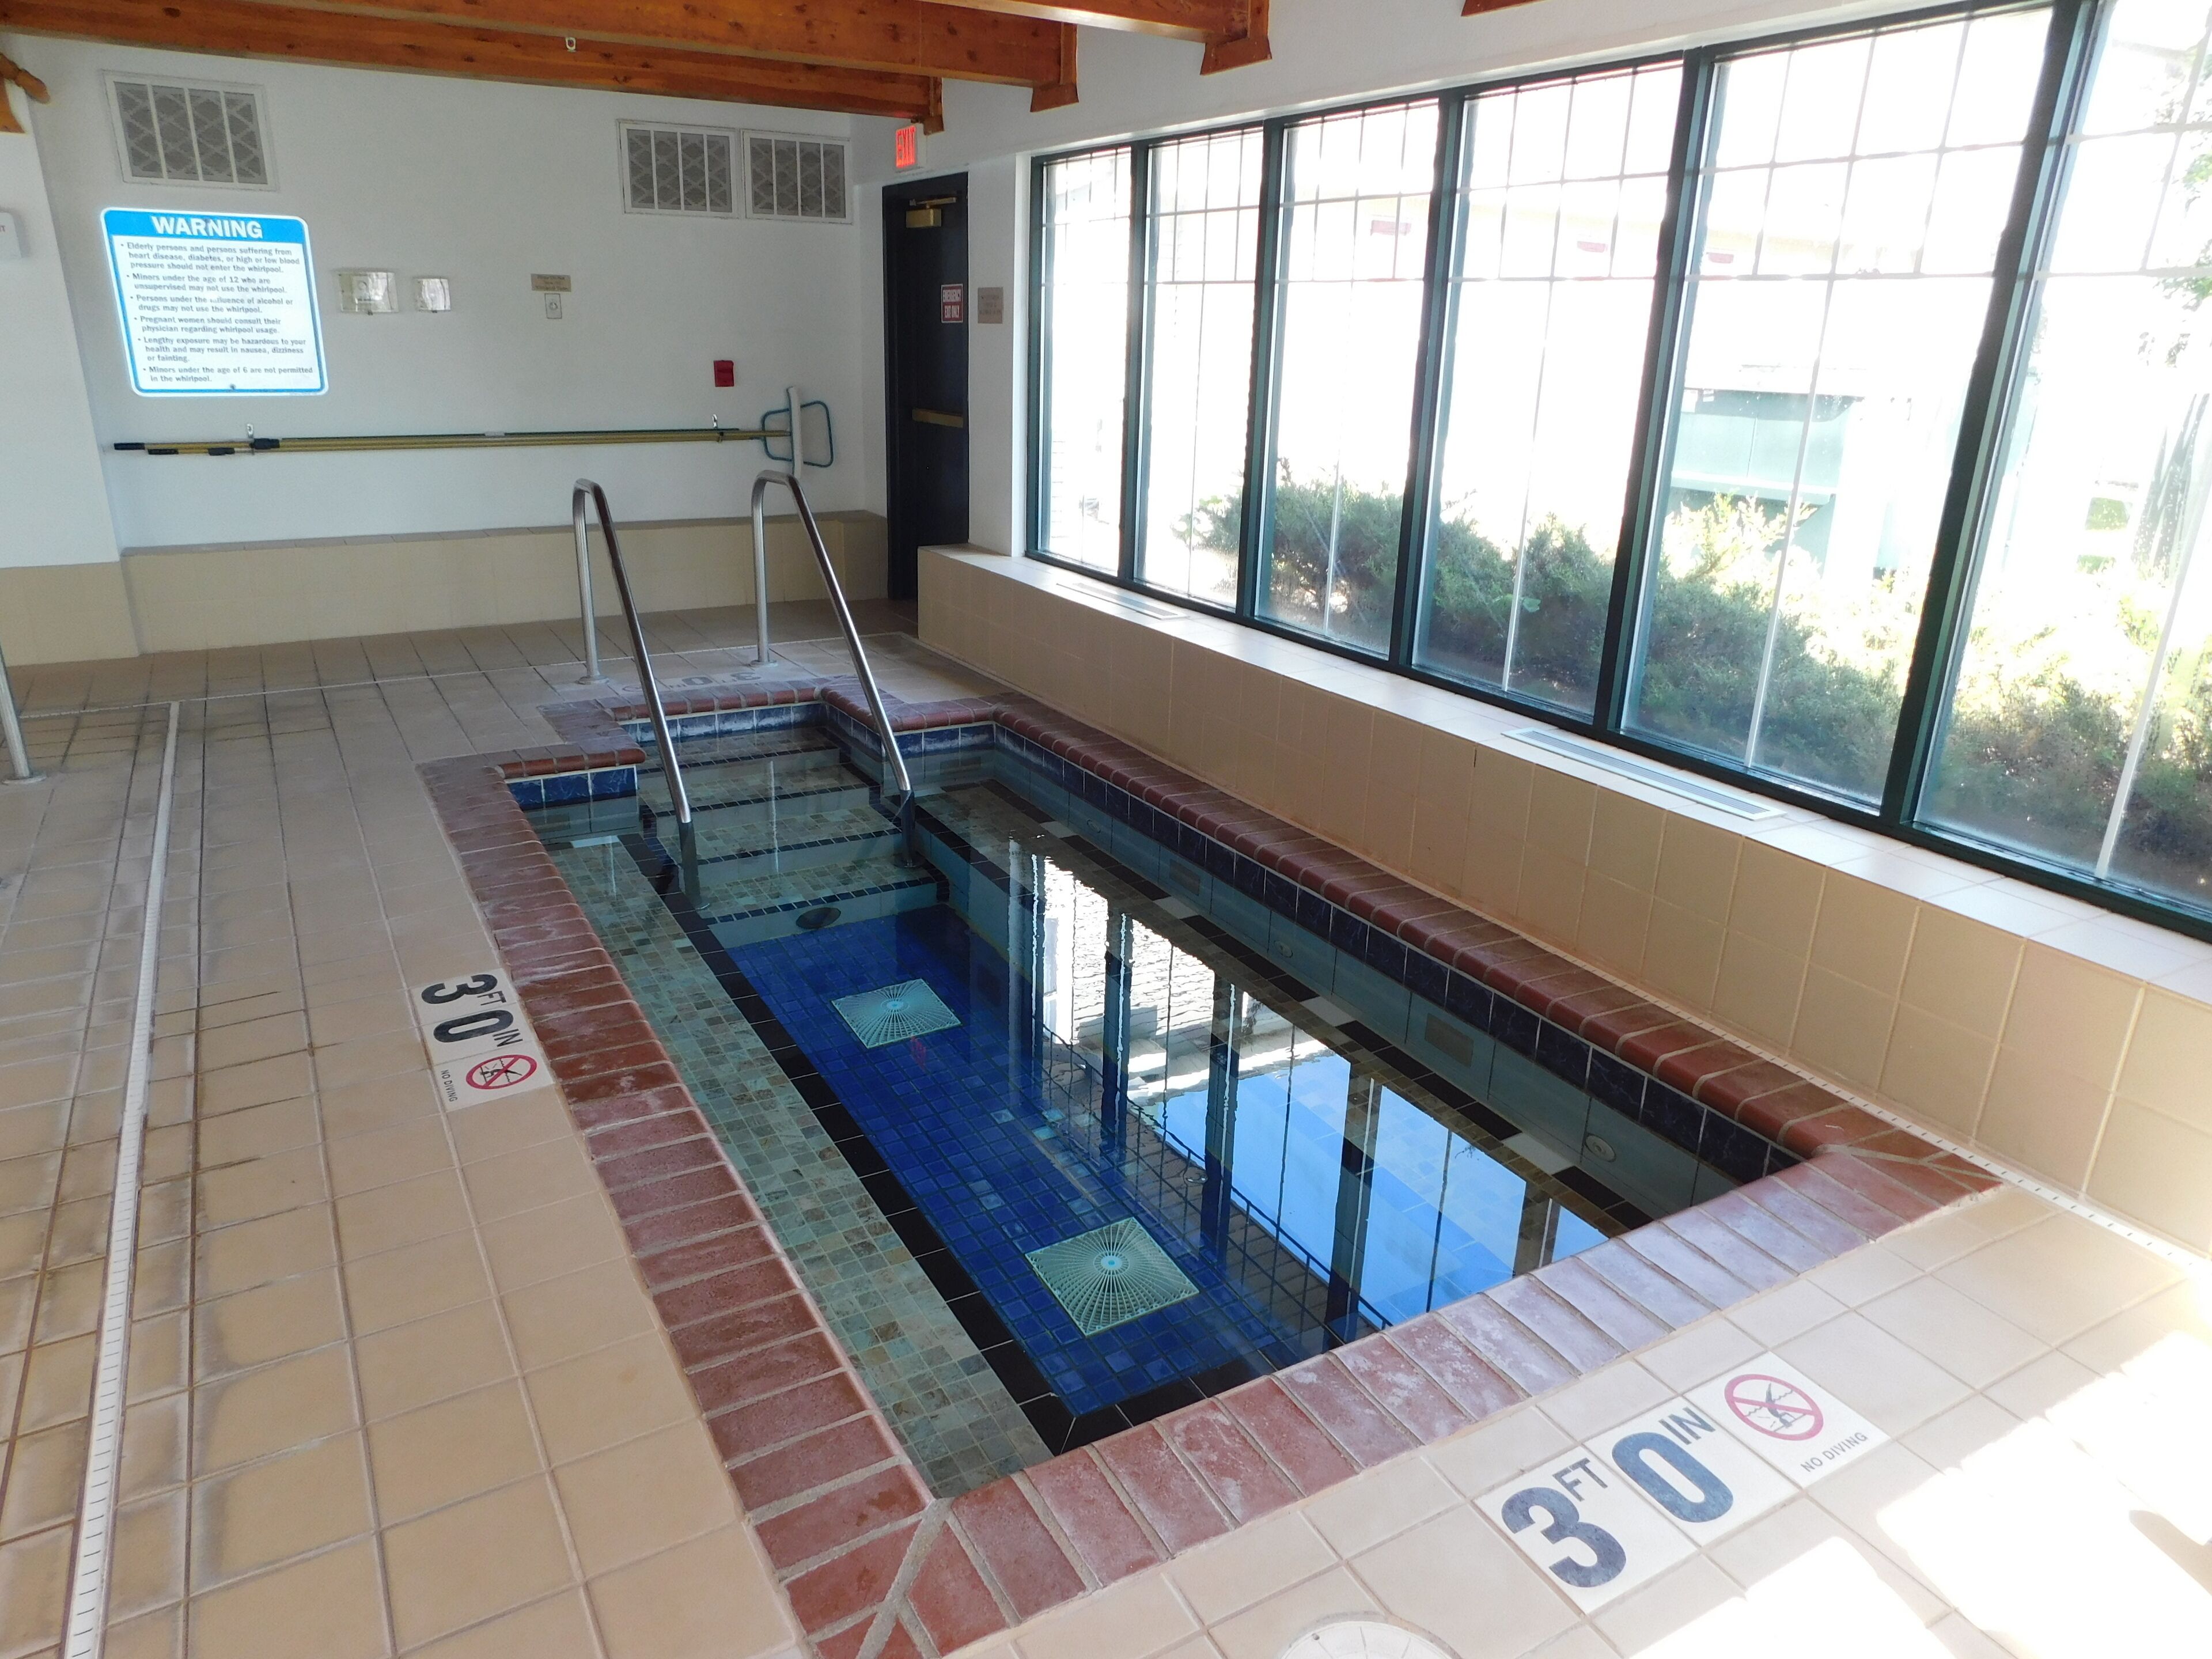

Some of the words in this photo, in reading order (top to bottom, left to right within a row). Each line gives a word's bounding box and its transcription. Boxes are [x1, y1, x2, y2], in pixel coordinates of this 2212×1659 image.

[896, 126, 915, 168] EXIT
[151, 216, 263, 238] WARNING
[127, 242, 153, 251] Elderly
[240, 247, 272, 256] suffering
[153, 253, 185, 261] disease,
[236, 256, 252, 264] high
[943, 289, 961, 302] EMERGENCY
[141, 316, 175, 324] Pregnant
[144, 336, 173, 344] Lengthy
[422, 974, 498, 1005] 3
[478, 990, 506, 1006] FT
[433, 1010, 513, 1043] 0
[493, 1028, 523, 1047] IN
[441, 1070, 449, 1079] NO
[445, 1081, 458, 1102] DIVING
[1659, 1406, 1716, 1445] IN
[1801, 1456, 1822, 1473] NO
[1824, 1432, 1868, 1461] DIVING
[1552, 1457, 1609, 1501] FT
[1612, 1431, 1733, 1523] 0
[1501, 1487, 1627, 1588] 3
